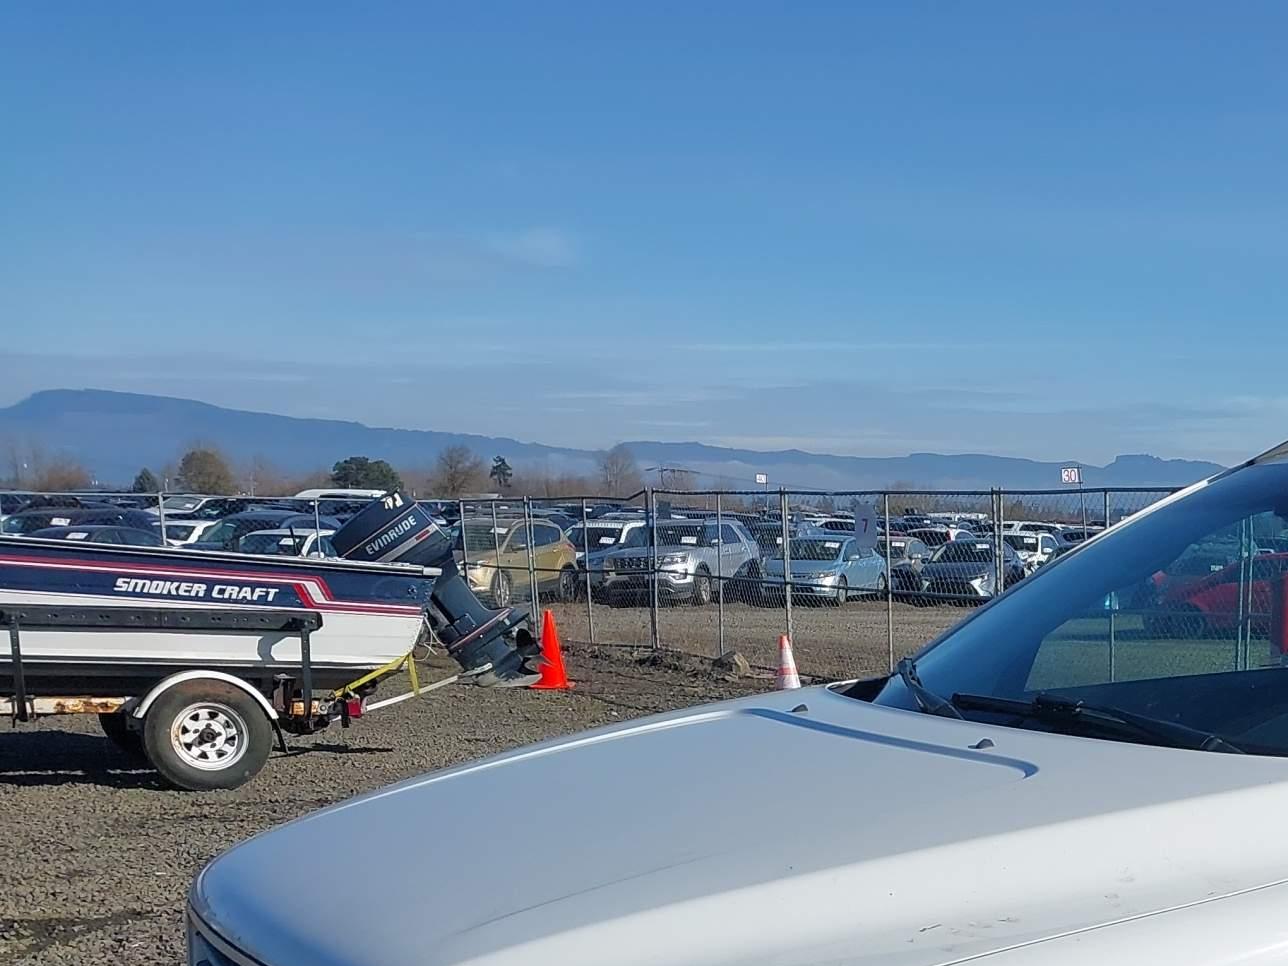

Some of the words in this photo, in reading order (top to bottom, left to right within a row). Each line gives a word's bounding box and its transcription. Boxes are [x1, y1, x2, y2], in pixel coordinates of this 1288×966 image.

[1063, 469, 1076, 482] 30
[365, 515, 417, 555] EVINRUDE
[113, 577, 207, 597] SMOKER
[211, 584, 280, 602] CRAFT
